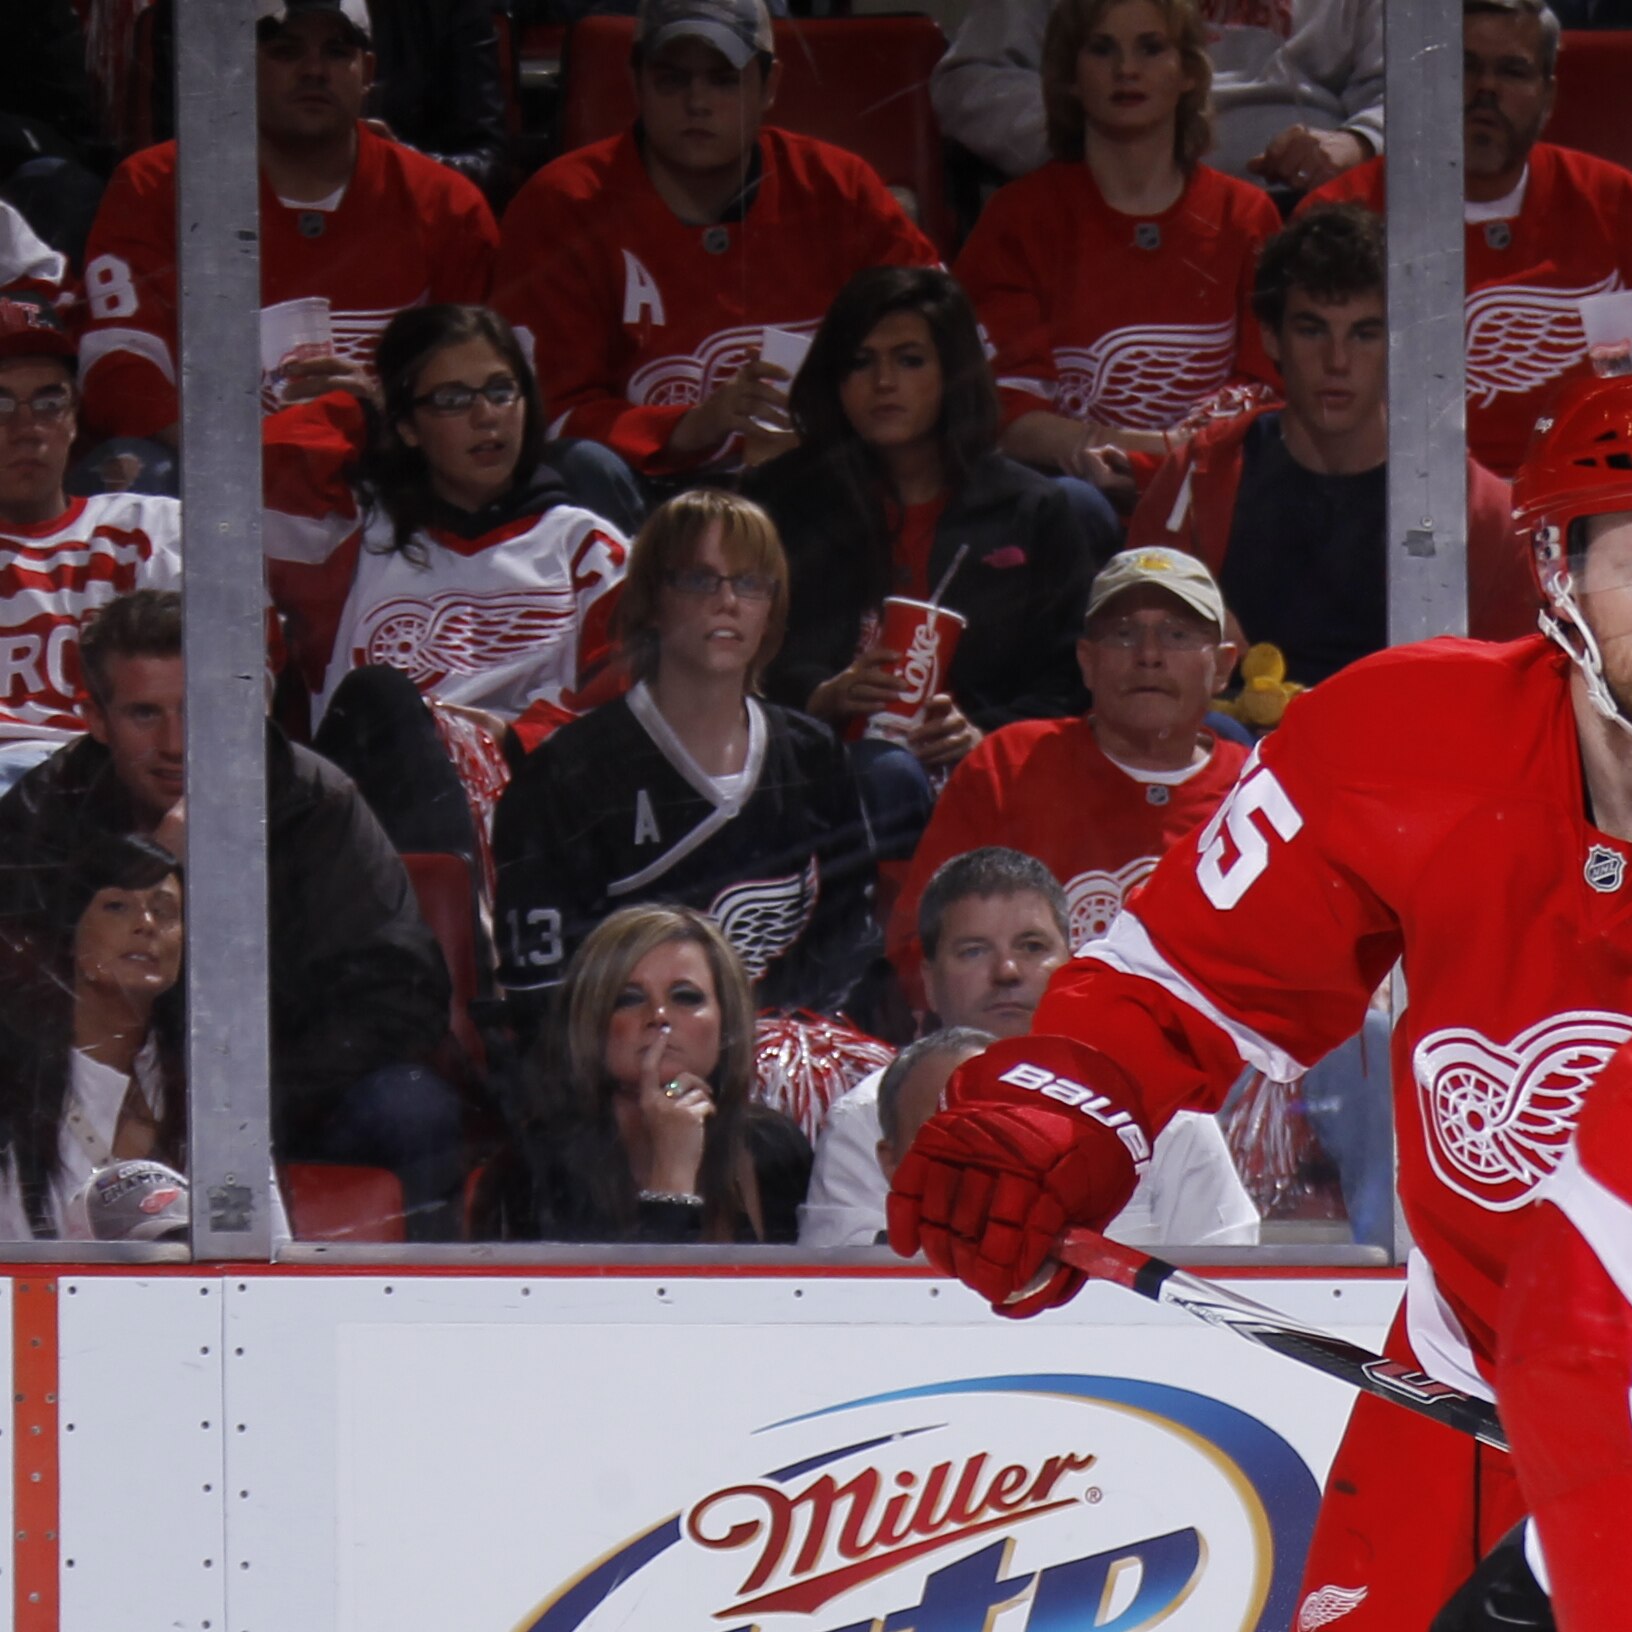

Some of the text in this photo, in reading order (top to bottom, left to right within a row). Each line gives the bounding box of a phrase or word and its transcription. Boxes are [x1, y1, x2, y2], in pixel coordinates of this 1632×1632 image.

[621, 247, 666, 326] A
[634, 789, 661, 845] A
[507, 908, 563, 967] 13
[685, 1451, 1097, 1600] Miller
